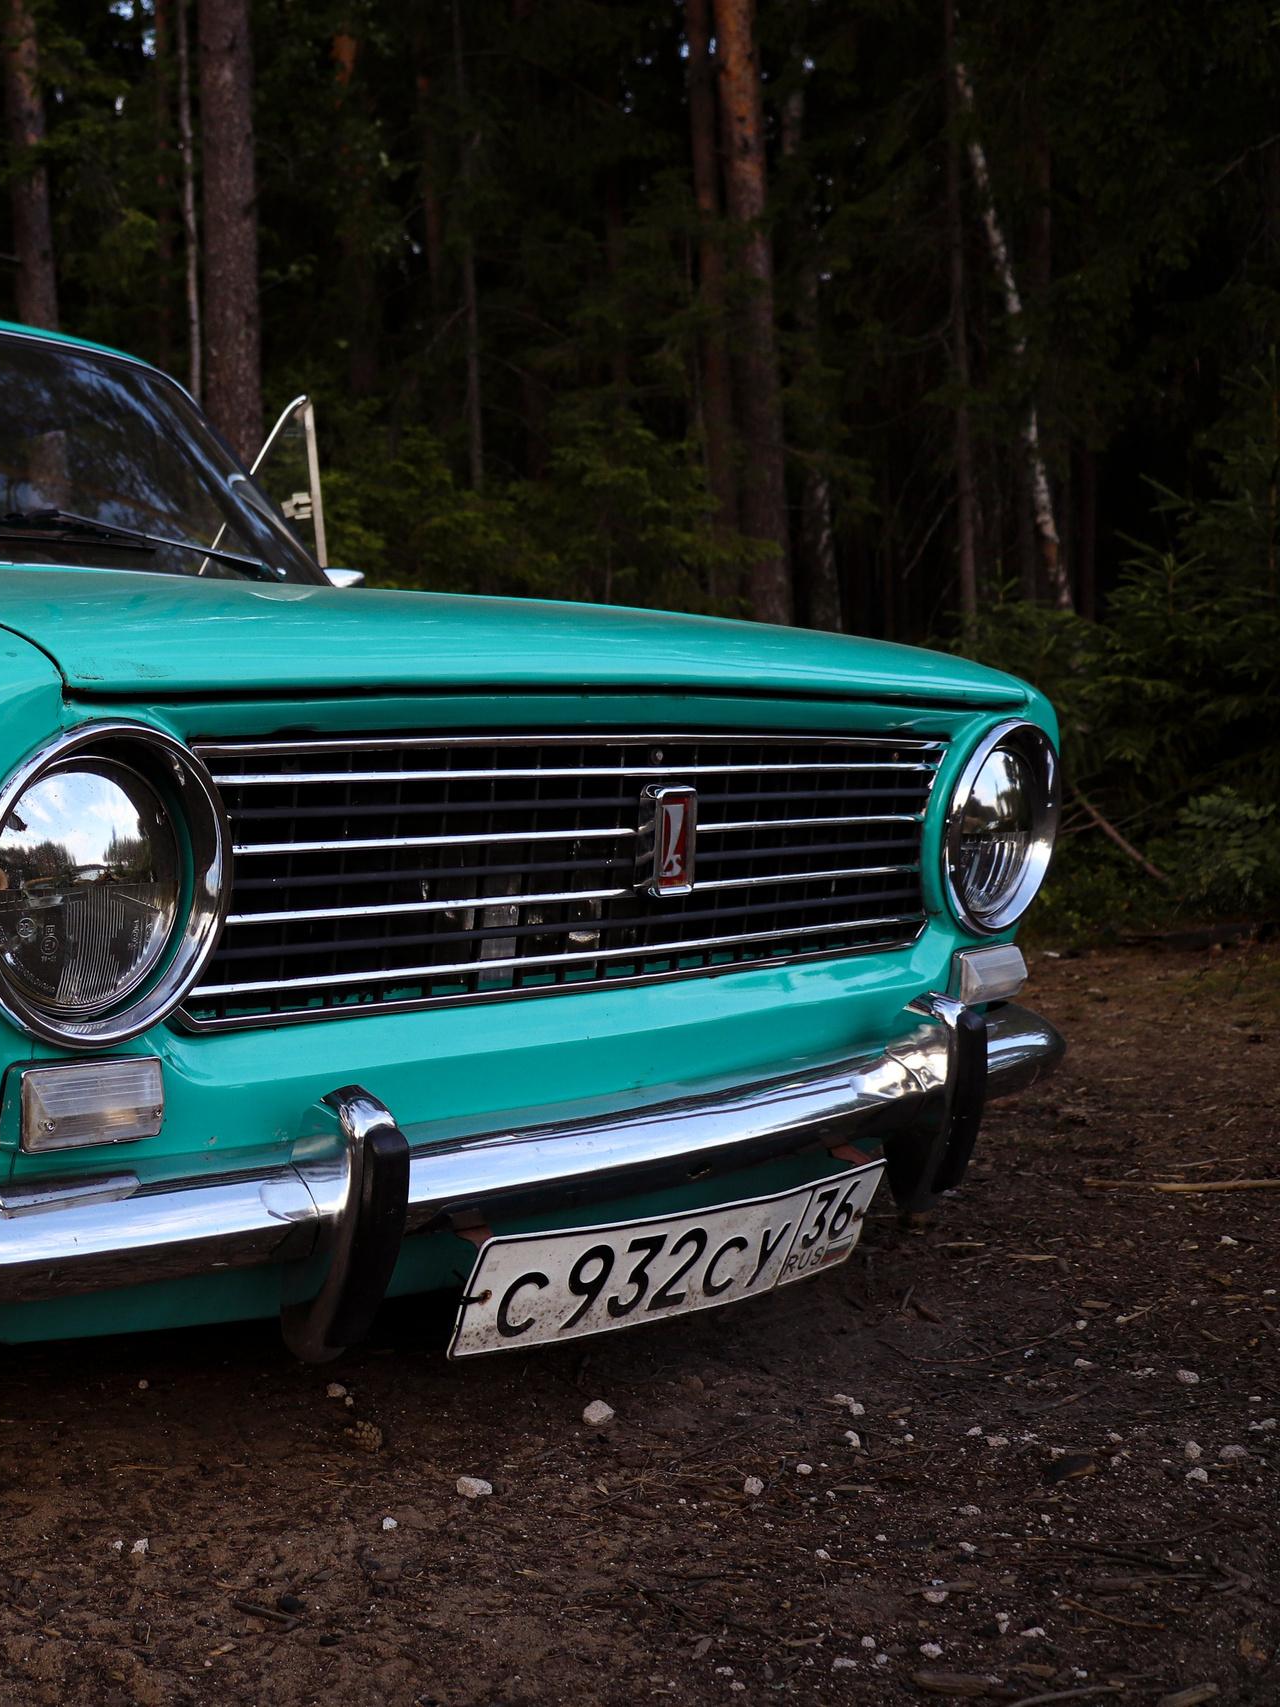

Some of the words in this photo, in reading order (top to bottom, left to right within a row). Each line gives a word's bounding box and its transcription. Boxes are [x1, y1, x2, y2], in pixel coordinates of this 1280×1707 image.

[496, 1221, 792, 1338] С932СУ
[801, 1180, 861, 1249] 36
[783, 1247, 827, 1277] RUS
